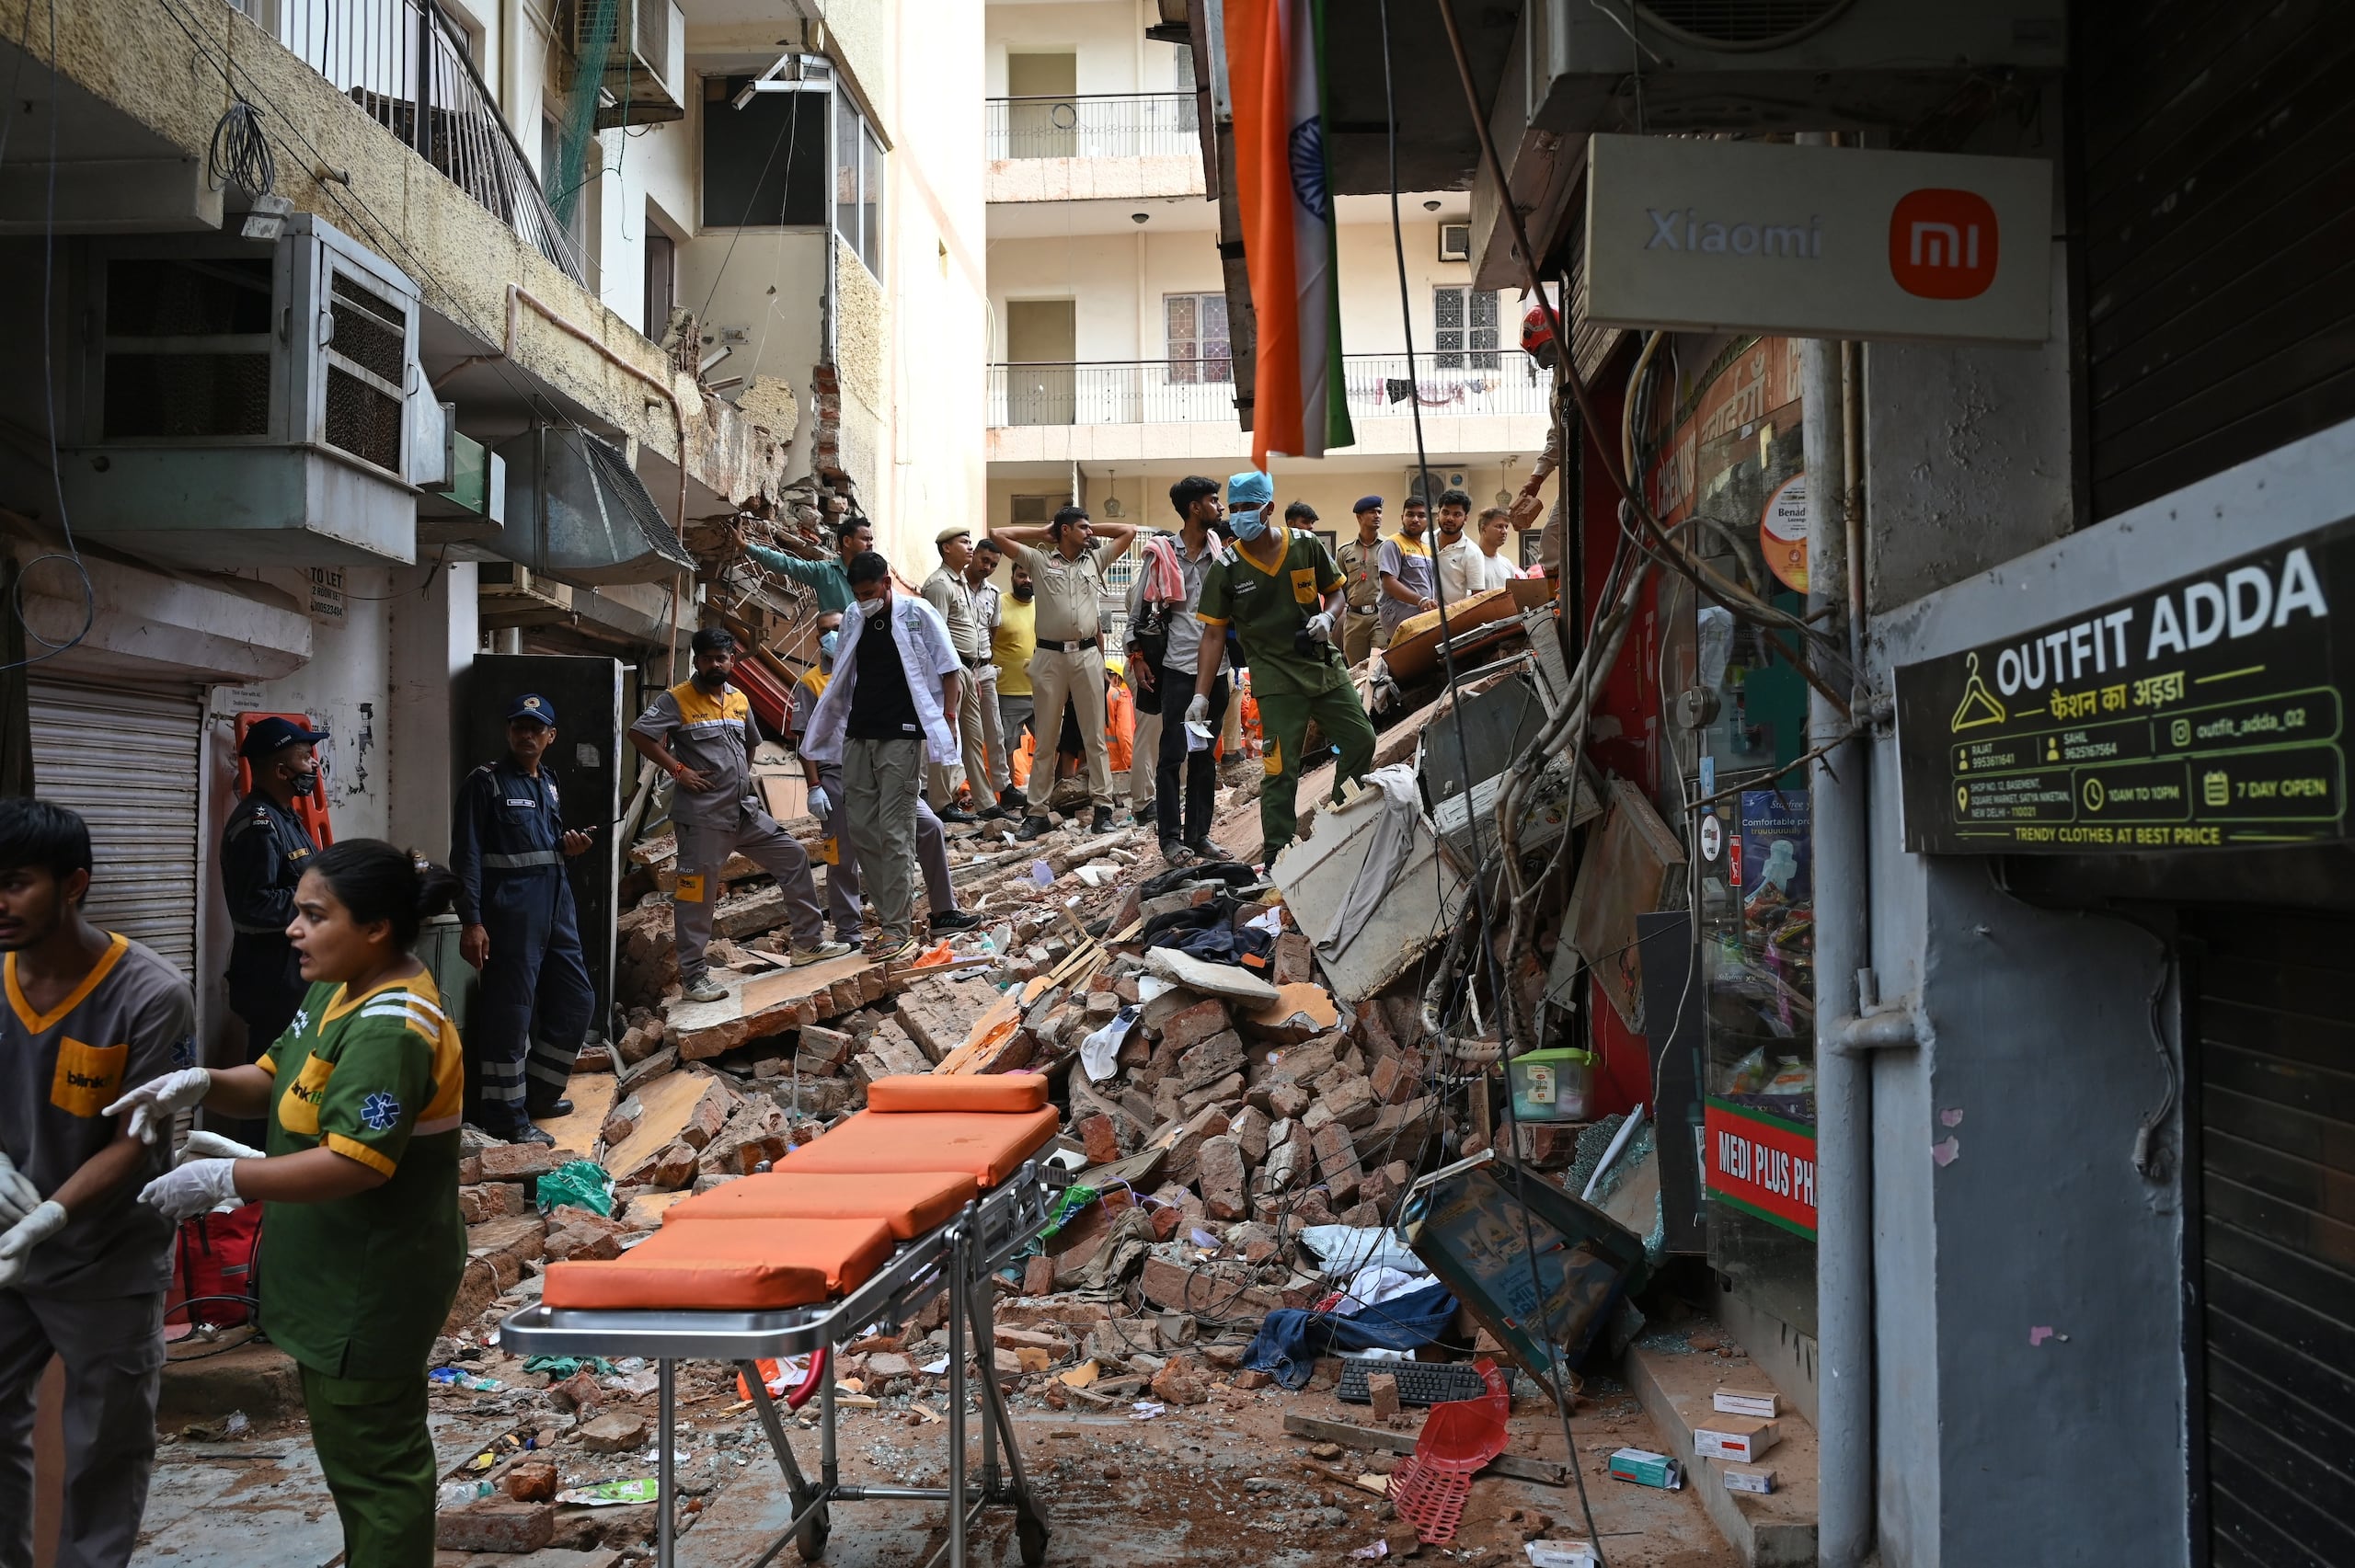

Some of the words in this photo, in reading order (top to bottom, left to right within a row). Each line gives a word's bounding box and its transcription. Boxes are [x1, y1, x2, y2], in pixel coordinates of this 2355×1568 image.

[1644, 208, 1822, 258] Xiaomi
[310, 567, 324, 584] TO
[326, 570, 342, 588] LET
[312, 586, 316, 595] 2
[1996, 607, 2133, 696] OUTFIT
[2146, 546, 2328, 661] ADDA
[2050, 687, 2097, 721] फैशन
[2100, 683, 2127, 711] का
[2196, 707, 2306, 738] outfit_adda_02
[2063, 731, 2088, 746] SAHIL
[1971, 743, 1993, 756] RAJAT
[1970, 783, 1985, 793] SHOP
[2108, 788, 2134, 802] 10AM
[2134, 787, 2151, 801] TO
[2151, 785, 2179, 800] 10PM
[2235, 782, 2246, 798] 7
[2247, 781, 2279, 798] DAY
[2280, 778, 2327, 797] OPEN
[1970, 795, 1993, 806] SQUARE
[1971, 808, 1985, 818] NEW
[1986, 807, 2005, 818] DELHI
[2012, 807, 2037, 817] 110021
[1742, 818, 1796, 827] Comfortable
[2015, 828, 2057, 841] TRENDY
[2058, 828, 2114, 843] CLOTHES
[2116, 828, 2133, 843] AT
[2135, 828, 2171, 844] BEST
[2174, 828, 2221, 845] PRICE
[1718, 1130, 1752, 1183] MEDI
[1755, 1143, 1790, 1197] PLUS
[1794, 1156, 1817, 1207] PH
